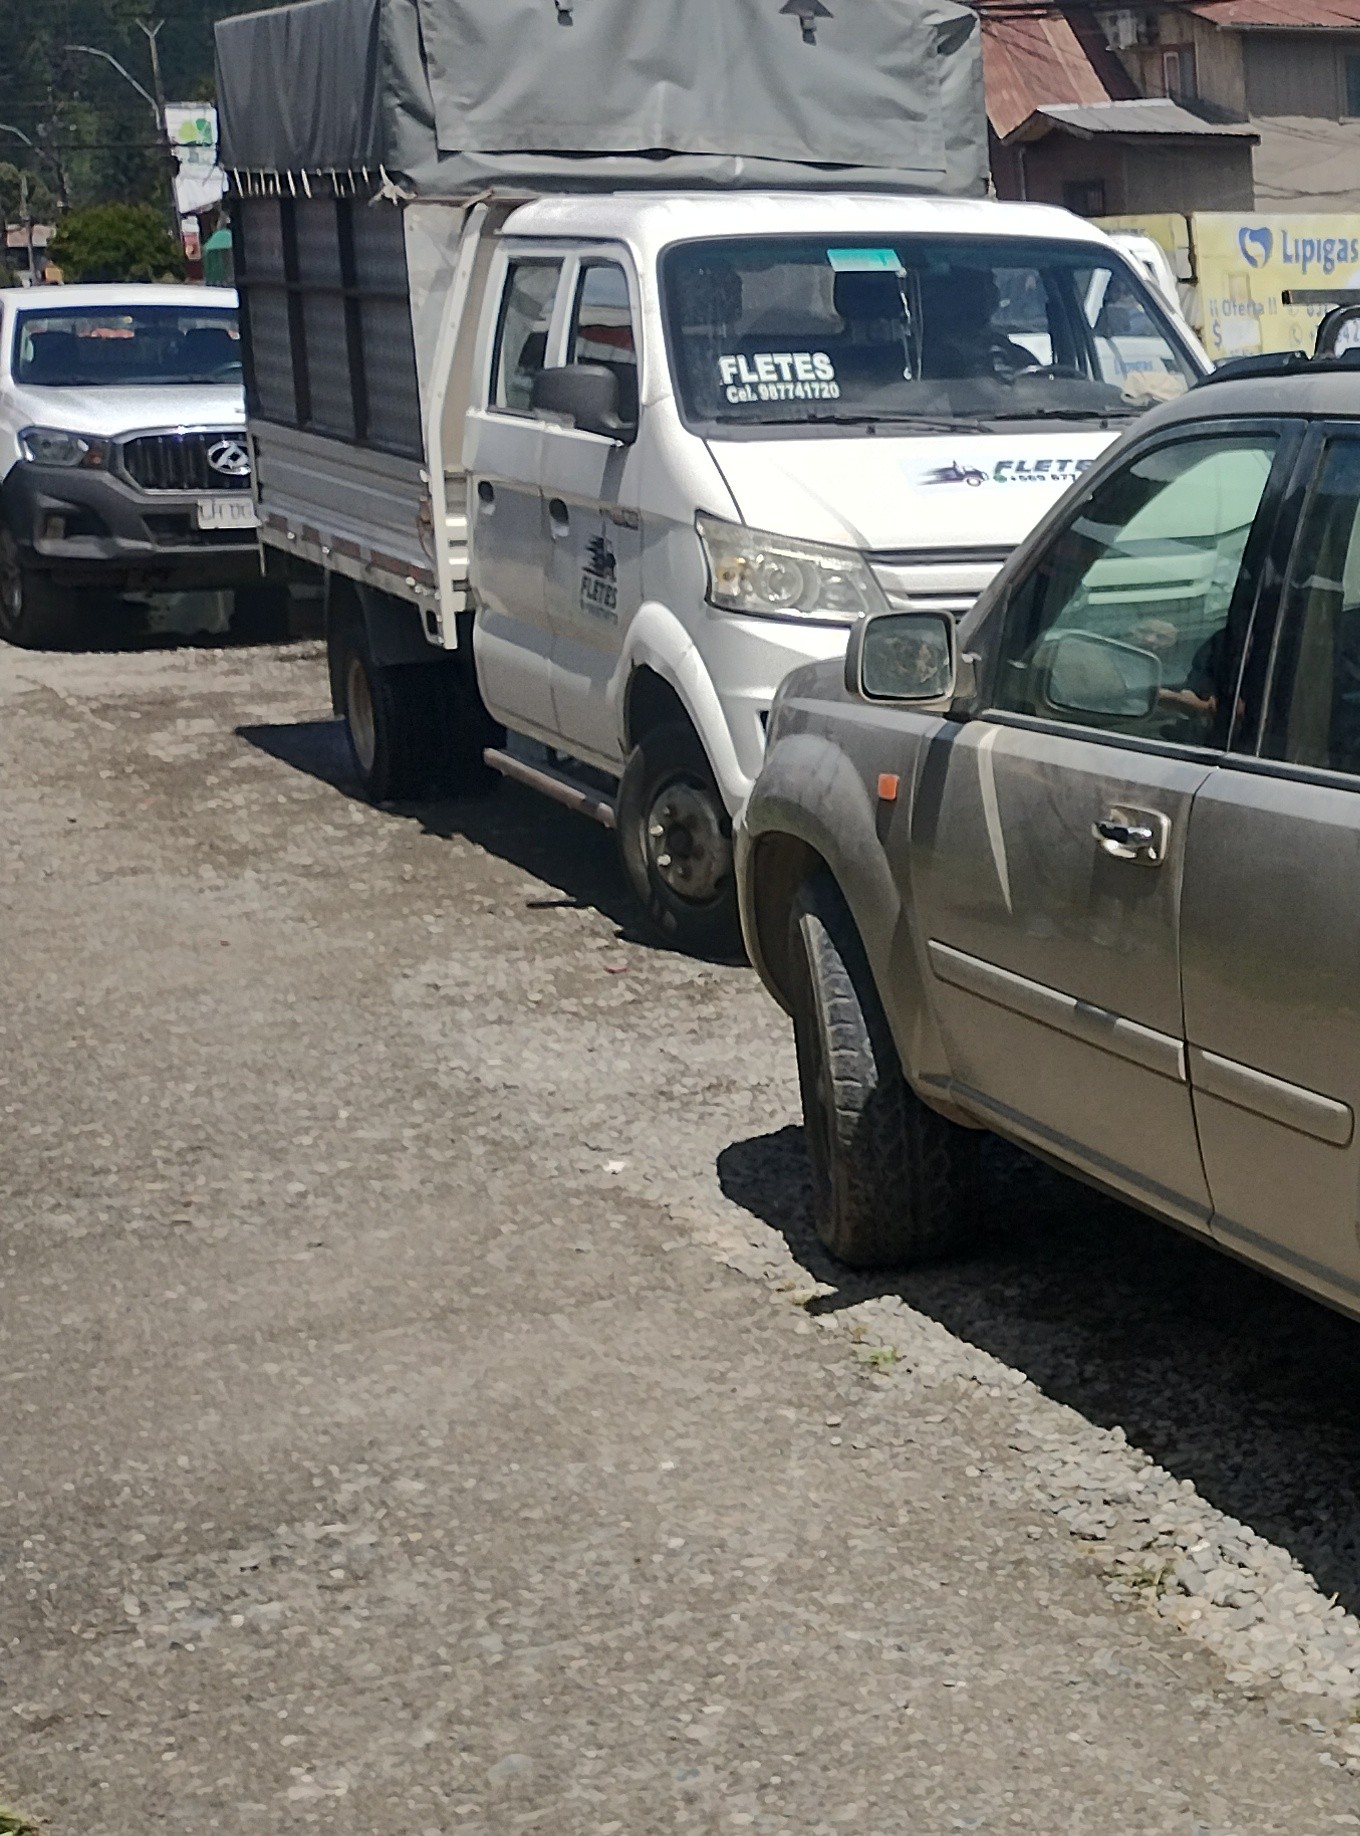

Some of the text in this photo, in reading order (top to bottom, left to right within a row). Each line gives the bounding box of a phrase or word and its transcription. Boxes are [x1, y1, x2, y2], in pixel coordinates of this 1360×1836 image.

[1281, 230, 1359, 275] Lipigas
[1212, 319, 1223, 349] $
[719, 352, 835, 385] FLETES
[758, 381, 840, 401] 987741720
[994, 458, 1096, 475] FLETE
